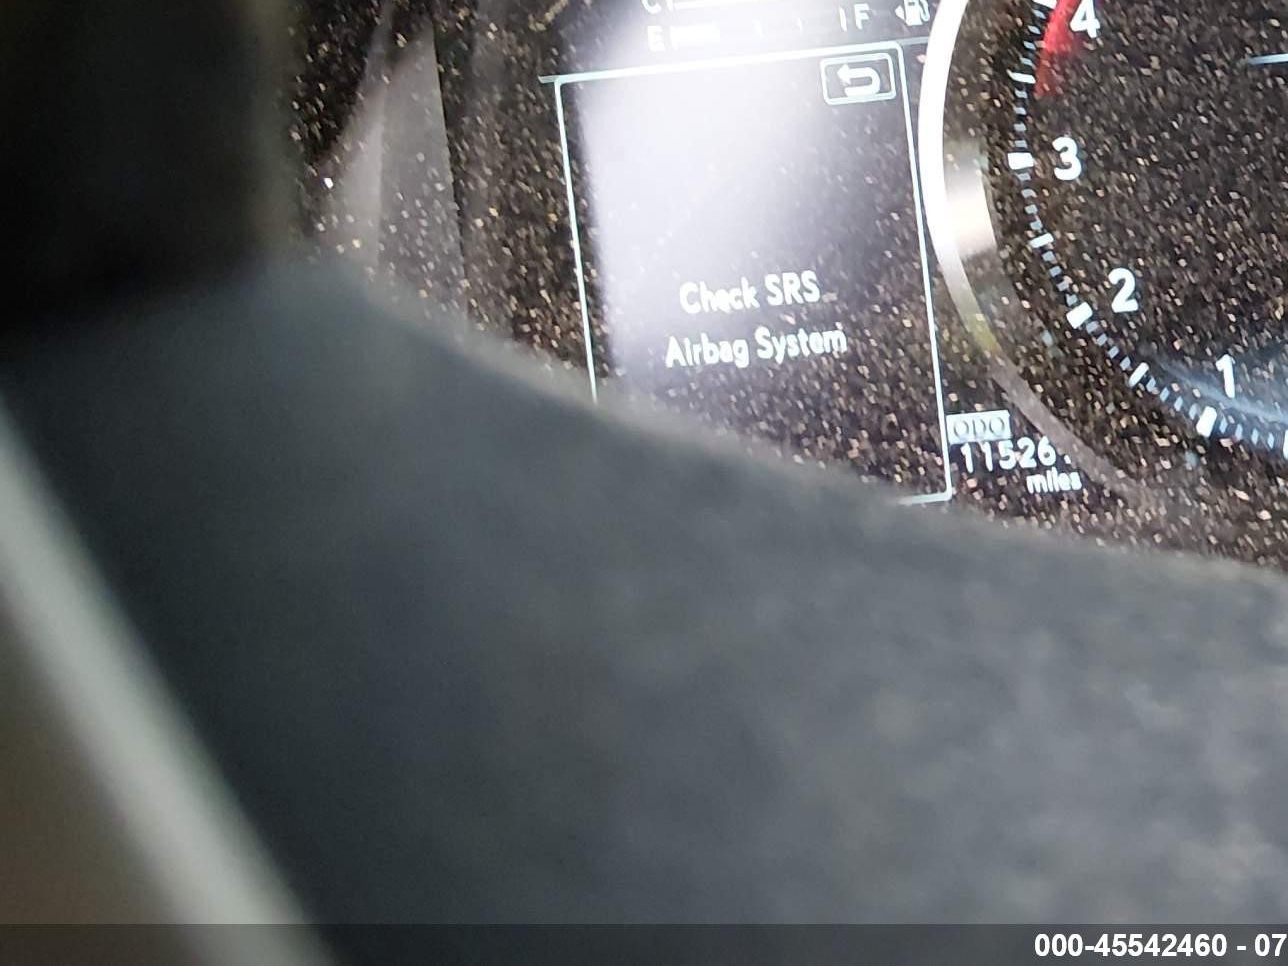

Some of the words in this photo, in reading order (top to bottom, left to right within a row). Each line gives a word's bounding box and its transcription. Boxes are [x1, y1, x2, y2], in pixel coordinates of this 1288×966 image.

[854, 2, 870, 30] F
[1052, 137, 1082, 181] 3
[679, 277, 759, 315] Check
[765, 270, 821, 306] SRS
[1108, 267, 1140, 314] 2
[665, 336, 749, 370] Airbag
[756, 327, 848, 362] System
[1214, 354, 1238, 398] 1
[953, 416, 1005, 438] ODO
[1026, 467, 1082, 494] miles
